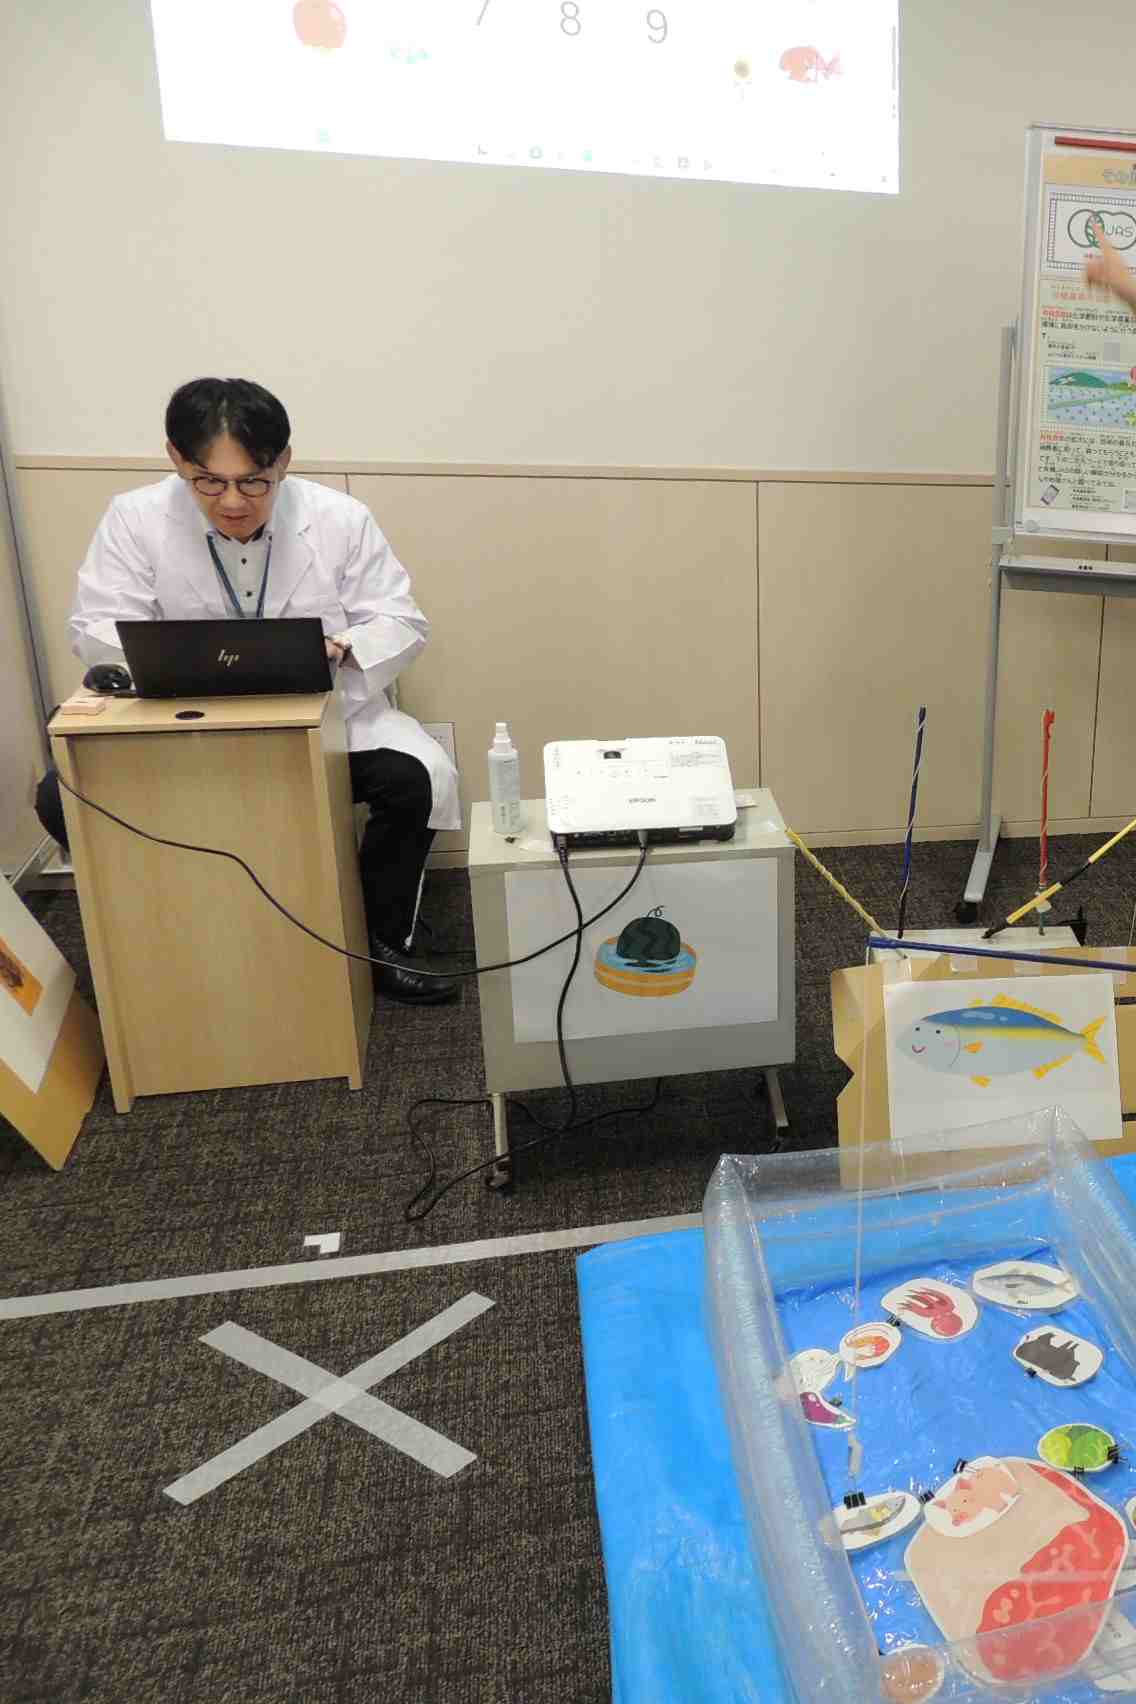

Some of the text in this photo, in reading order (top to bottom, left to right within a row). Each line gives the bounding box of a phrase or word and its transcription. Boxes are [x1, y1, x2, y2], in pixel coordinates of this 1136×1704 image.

[560, 1, 581, 36] 8
[646, 9, 669, 44] 9
[1105, 224, 1134, 238] JAS
[216, 650, 240, 667] hp
